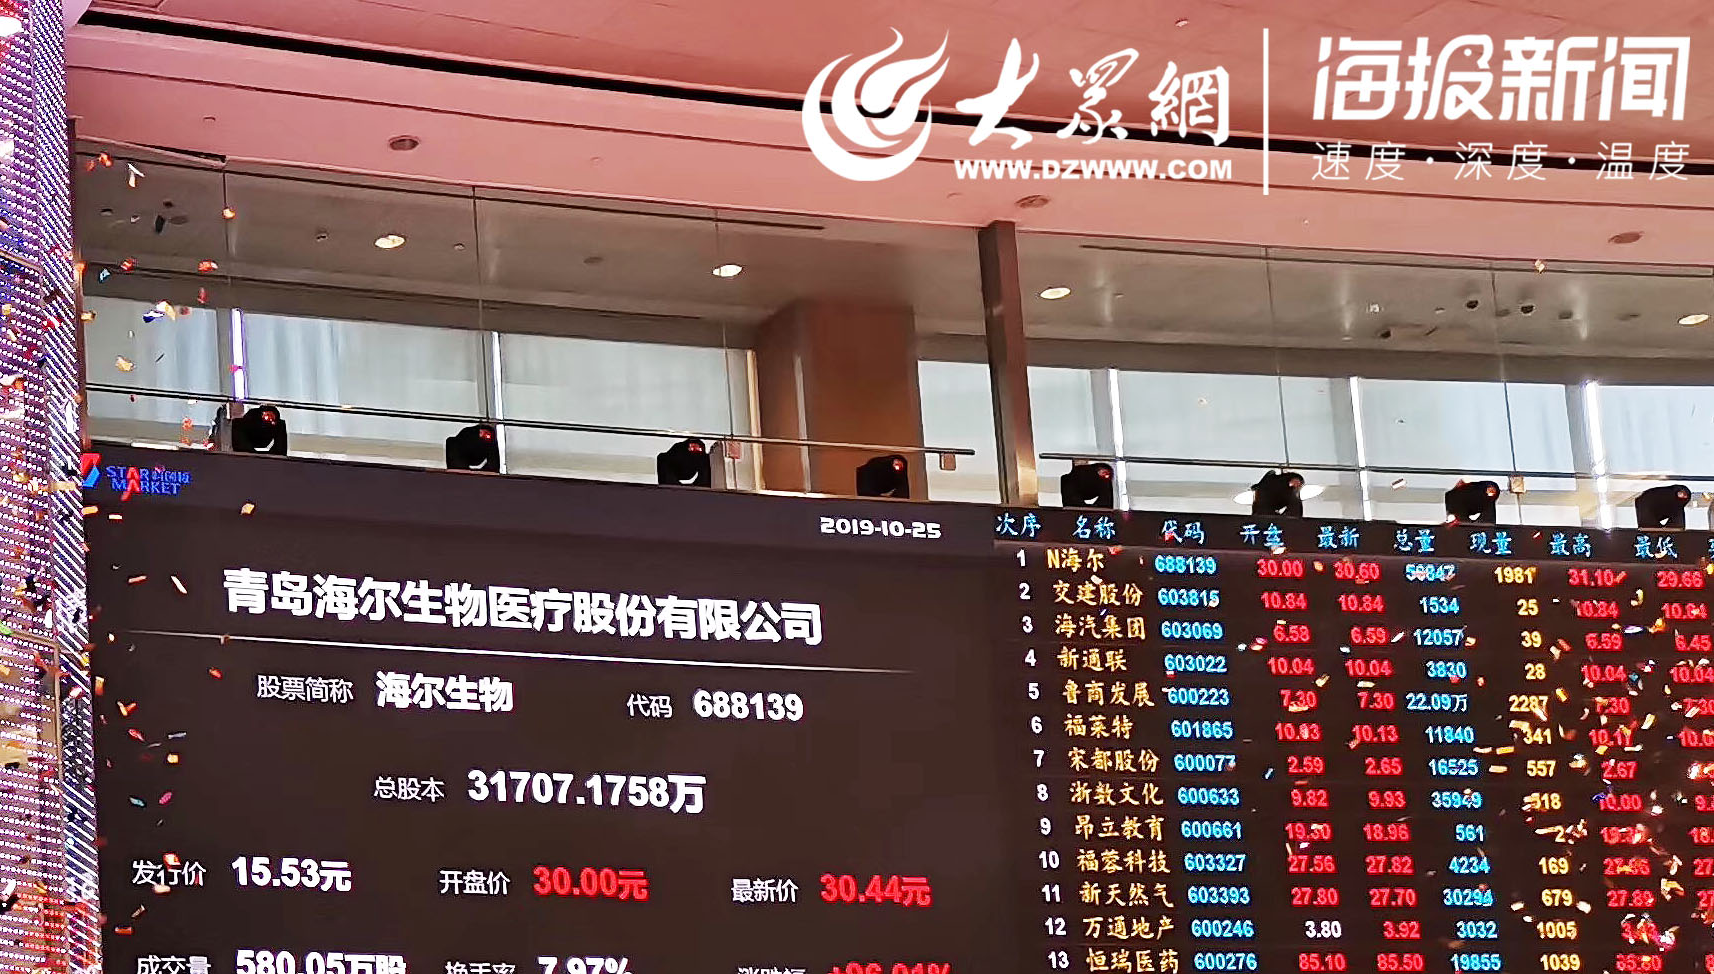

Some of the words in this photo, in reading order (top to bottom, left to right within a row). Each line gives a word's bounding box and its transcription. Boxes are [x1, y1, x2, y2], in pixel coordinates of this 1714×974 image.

[111, 478, 180, 501] MARKET
[820, 517, 941, 538] 2019-10-25
[996, 513, 1041, 538] 次序
[1072, 516, 1116, 539] 名称
[1162, 520, 1205, 545] 代码
[1240, 524, 1285, 548] 开盘
[1317, 526, 1360, 549] 最新
[1394, 529, 1435, 552] 总量
[1470, 532, 1512, 555] 现量
[1550, 534, 1592, 557] 最高
[1635, 536, 1678, 558] 最低
[1017, 549, 1025, 566] 1
[1047, 548, 1104, 573] N海尔
[1155, 556, 1216, 574] 688139
[1257, 559, 1304, 577] 30.00
[1495, 567, 1533, 584] 1981
[223, 566, 823, 645] 青岛海尔生物医疗股份有限公司
[1019, 583, 1030, 599] 2
[1053, 581, 1143, 606] 交建股份
[1158, 589, 1220, 608] 603815
[1261, 592, 1307, 609] 10.84
[1338, 595, 1383, 612] 10.84
[1419, 597, 1459, 614] 1534
[1517, 599, 1539, 617] 25
[1023, 616, 1033, 632] 3
[1055, 616, 1146, 639] 海汽集团
[1161, 621, 1223, 640] 603069
[1274, 625, 1310, 642] 6.58
[1413, 629, 1462, 646] 12057
[1522, 631, 1542, 647] 39
[1025, 650, 1036, 666] 4
[1057, 648, 1127, 672] 新通联
[1164, 655, 1227, 673] 603022
[1268, 657, 1314, 675] 10.04
[1345, 660, 1392, 676] 10.04
[1525, 663, 1546, 680] 28
[255, 674, 353, 706] 股票简称
[376, 672, 513, 713] 海尔生物
[626, 692, 673, 719] 代码
[694, 689, 803, 722] 688139
[1028, 683, 1039, 699] 5
[1062, 681, 1155, 706] 鲁商发展
[1168, 688, 1229, 706] 600223
[1358, 692, 1395, 709] 7.30
[1406, 694, 1467, 712] 22.09万
[1031, 717, 1042, 733] 6
[1064, 714, 1133, 739] 福莱特
[1171, 720, 1233, 739] 601865
[1352, 726, 1398, 742] 10.13
[1425, 727, 1474, 744] 11840
[1034, 751, 1044, 767] 7
[1068, 748, 1160, 772] 宋都股份
[1174, 754, 1235, 772] 600077
[1288, 756, 1324, 774] 2.59
[1365, 758, 1402, 774] 2.65
[1429, 760, 1478, 776] 16525
[1526, 761, 1556, 777] 557
[373, 775, 444, 802] 总股本
[468, 771, 706, 813] 31707.1758万
[1037, 784, 1048, 801] 8
[1069, 782, 1164, 806] 浙数文化
[1178, 787, 1240, 805] 600633
[1291, 790, 1328, 807] 9.82
[1368, 791, 1405, 808] 9.93
[1040, 818, 1051, 834] 9
[1074, 815, 1164, 840] 昂立教育
[1181, 821, 1242, 839] 600661
[1363, 825, 1409, 841] 18.96
[1456, 824, 1484, 841] 561
[1039, 852, 1059, 868] 10
[1077, 849, 1171, 873] 福蓉科技
[1184, 854, 1246, 872] 603327
[1288, 855, 1335, 872] 27.56
[1366, 856, 1413, 874] 27.82
[1449, 857, 1491, 874] 4234
[1539, 857, 1569, 874] 169
[131, 859, 206, 888] 发行价
[231, 856, 352, 892] 15.53元
[439, 868, 510, 896] 开盘价
[534, 867, 648, 902] 30.00元
[731, 877, 798, 904] 最新价
[821, 873, 931, 907] 30.44元
[1042, 885, 1061, 902] 11
[1079, 881, 1174, 907] 新天然气
[1188, 886, 1250, 904] 603393
[1292, 888, 1338, 905] 27.80
[1370, 889, 1417, 906] 27.70
[1542, 890, 1572, 906] 679
[1045, 918, 1066, 935] 12
[1083, 916, 1175, 940] 万通地产
[1191, 920, 1254, 937] 600246
[1305, 921, 1341, 938] 3.80
[1383, 922, 1420, 938] 3.92
[1456, 922, 1497, 938] 3032
[1536, 922, 1576, 939] 1005
[1048, 952, 1069, 968] 13
[1086, 948, 1179, 974] 恒瑞医药
[1194, 953, 1257, 970] 600276
[1299, 953, 1346, 970] 85.10
[1450, 955, 1501, 971] 19855
[1540, 956, 1580, 972] 1039
